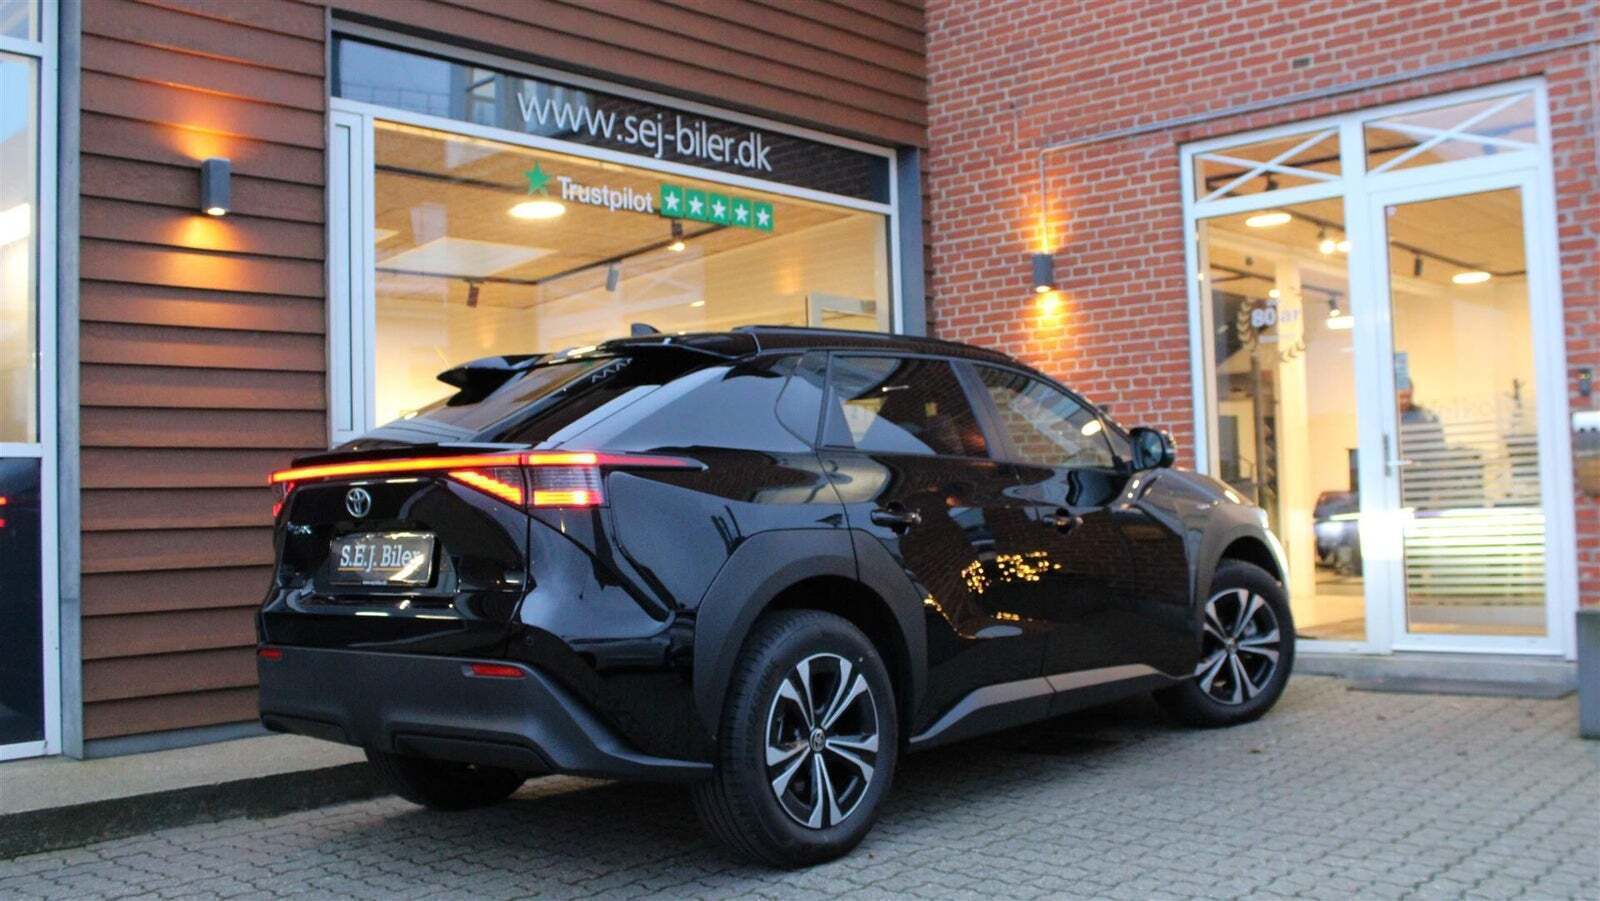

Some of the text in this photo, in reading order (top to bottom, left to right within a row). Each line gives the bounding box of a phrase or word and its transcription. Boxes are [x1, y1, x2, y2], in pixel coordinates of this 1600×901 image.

[517, 93, 772, 171] www.sej-biler.dk
[557, 175, 653, 212] Trustpilot
[340, 545, 377, 572] S.E.J.
